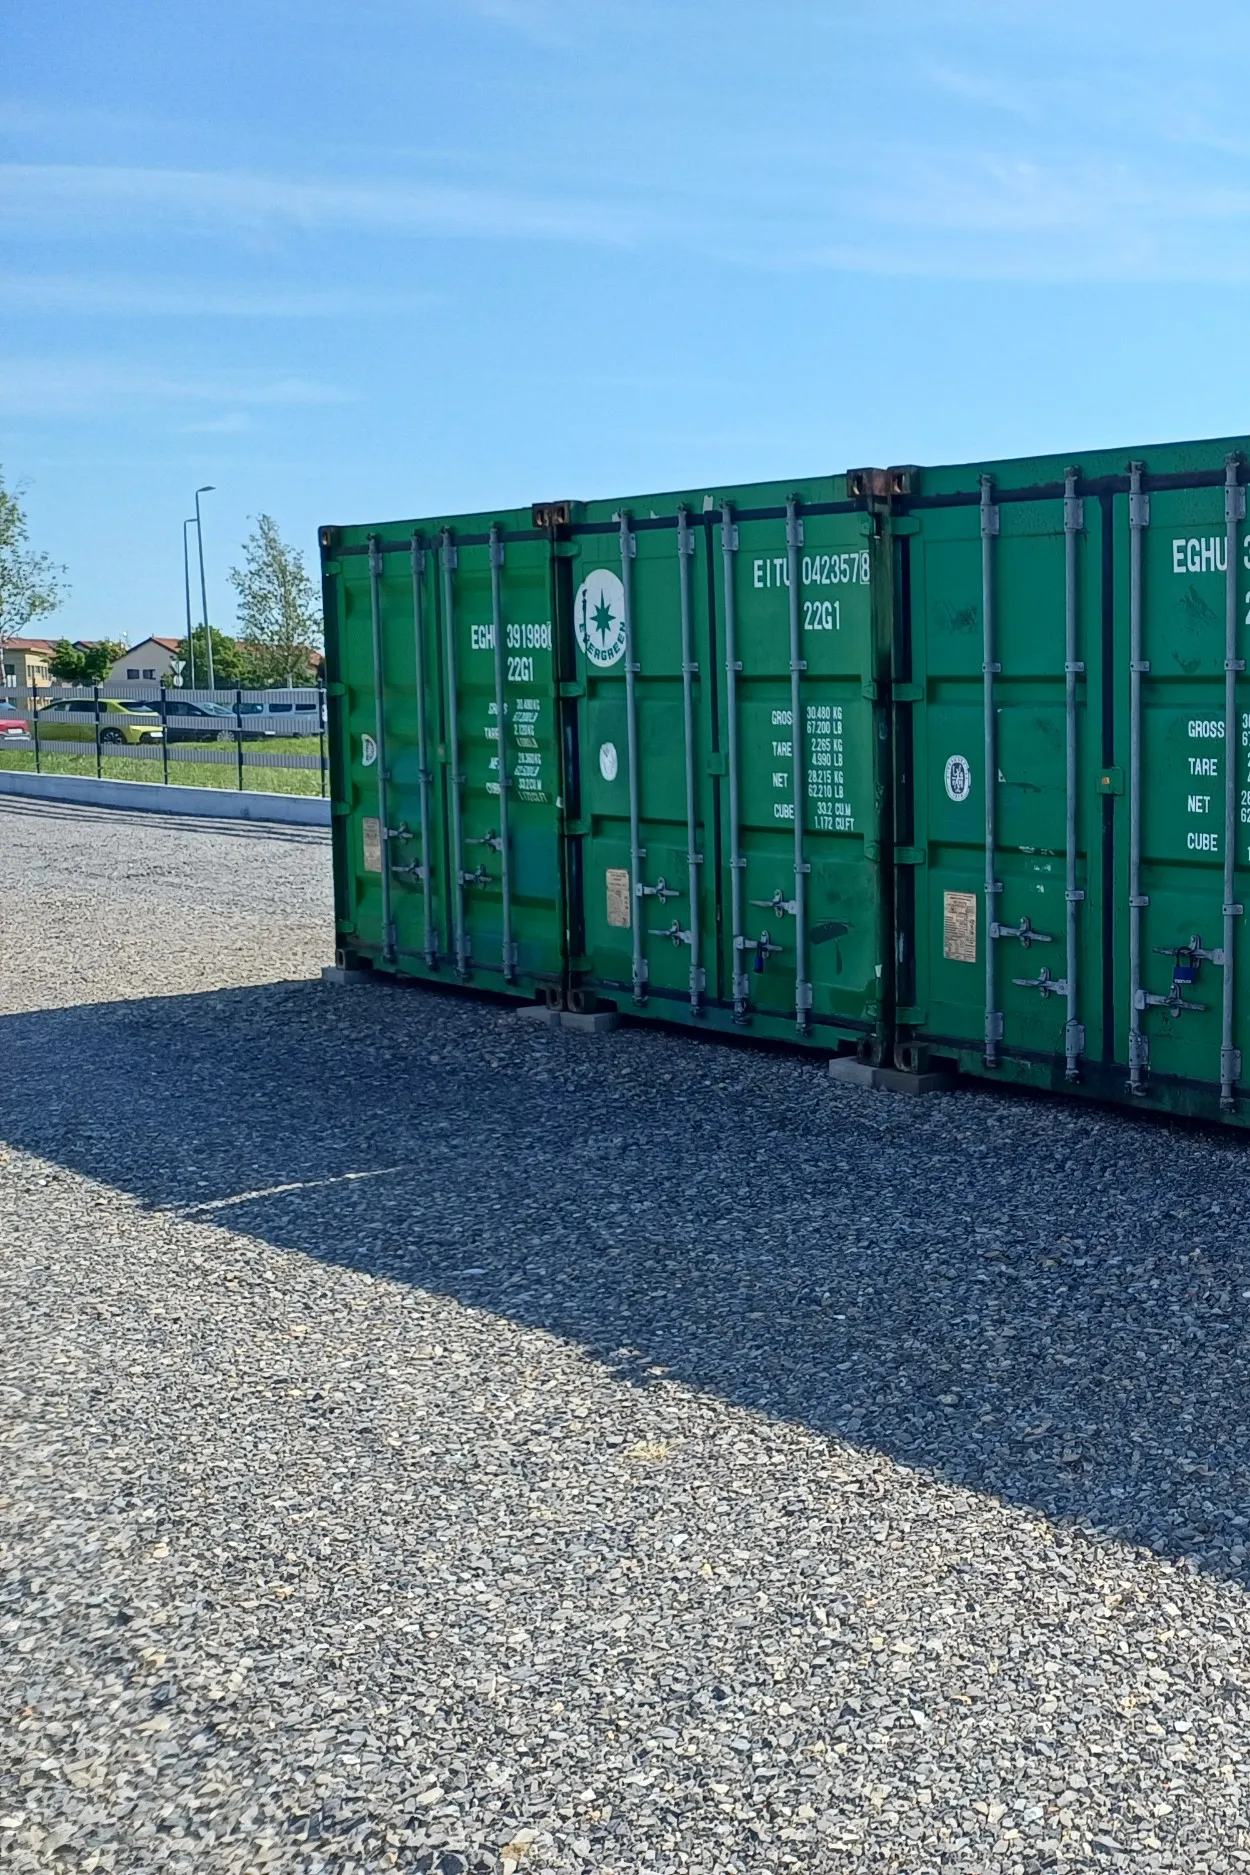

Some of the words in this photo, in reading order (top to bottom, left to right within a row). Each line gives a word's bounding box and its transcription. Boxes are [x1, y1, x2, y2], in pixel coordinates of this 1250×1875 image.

[1172, 537, 1227, 573] EGHU
[802, 550, 870, 585] 0423578
[804, 600, 840, 630] 22G1
[507, 656, 534, 682] 22G1
[771, 711, 793, 725] GROS
[1188, 720, 1225, 738] GROSS
[772, 741, 792, 757] TARE
[1188, 758, 1217, 776] TARE
[772, 772, 788, 788] NET
[773, 803, 795, 819] CUBE
[1187, 795, 1210, 813] NET
[1187, 832, 1218, 851] CUBE
